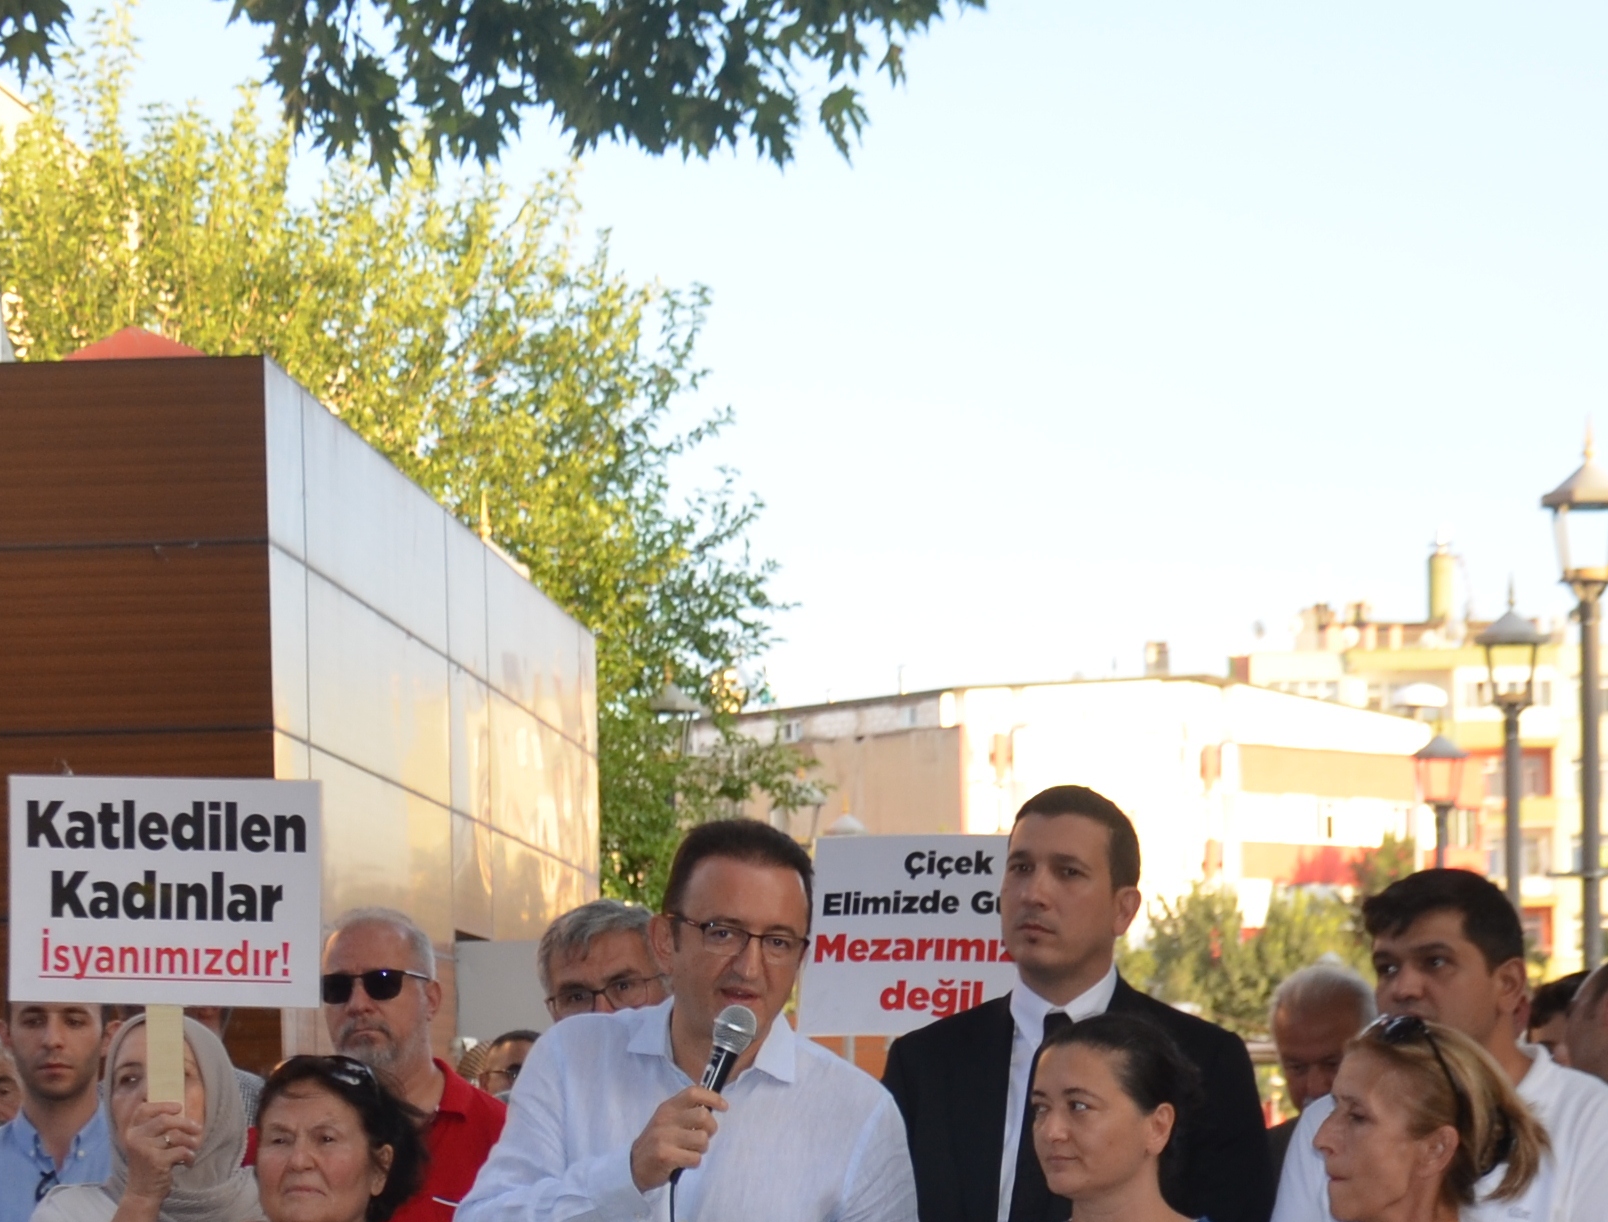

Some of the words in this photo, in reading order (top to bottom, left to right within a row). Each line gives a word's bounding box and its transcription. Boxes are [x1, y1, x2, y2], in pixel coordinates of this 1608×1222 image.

[26, 800, 307, 852] Katledilen
[904, 850, 994, 880] Çiçek
[50, 870, 283, 922] Kadınlar
[822, 890, 960, 917] Elimizde
[41, 928, 290, 980] İsyanımızdır!
[879, 979, 984, 1019] değil
